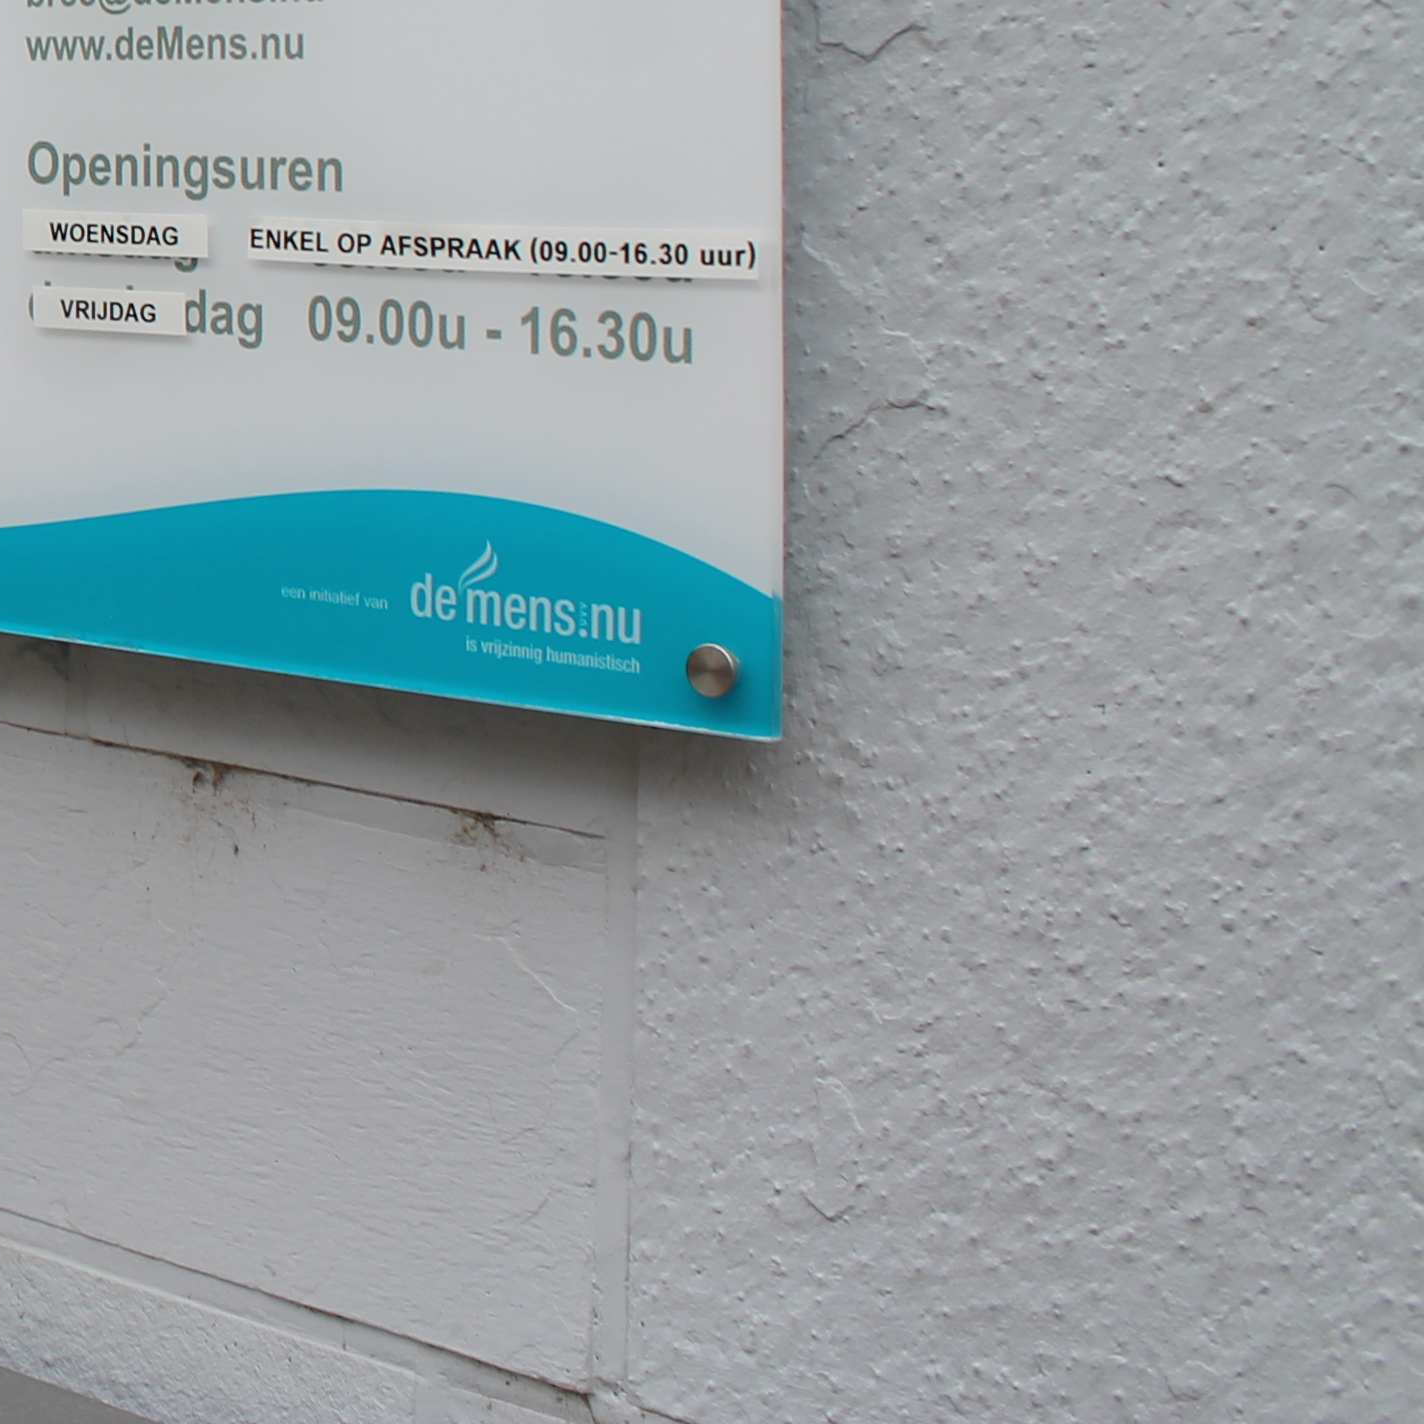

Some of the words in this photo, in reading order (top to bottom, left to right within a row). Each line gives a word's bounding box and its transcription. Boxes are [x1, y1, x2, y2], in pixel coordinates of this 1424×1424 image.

[25, 25, 304, 61] www.deMens.nu
[27, 140, 344, 201] Openingsuren
[49, 222, 179, 246] WOENSDAG
[250, 228, 329, 253] ENKEL
[337, 232, 372, 254] OP
[380, 234, 522, 261] AFSPRAAK
[530, 237, 689, 266] (09.00-16.30
[700, 241, 756, 270] uur)
[60, 299, 157, 323] VRIJDAG
[184, 288, 263, 350] dag
[308, 295, 466, 350] 09.00u
[520, 306, 693, 365] 16.30u
[280, 586, 306, 600] een
[309, 587, 361, 607] initiatief
[363, 596, 389, 610] van
[465, 634, 477, 653] is
[480, 638, 543, 665] vrijzinnig
[546, 645, 642, 675] humanistisch
